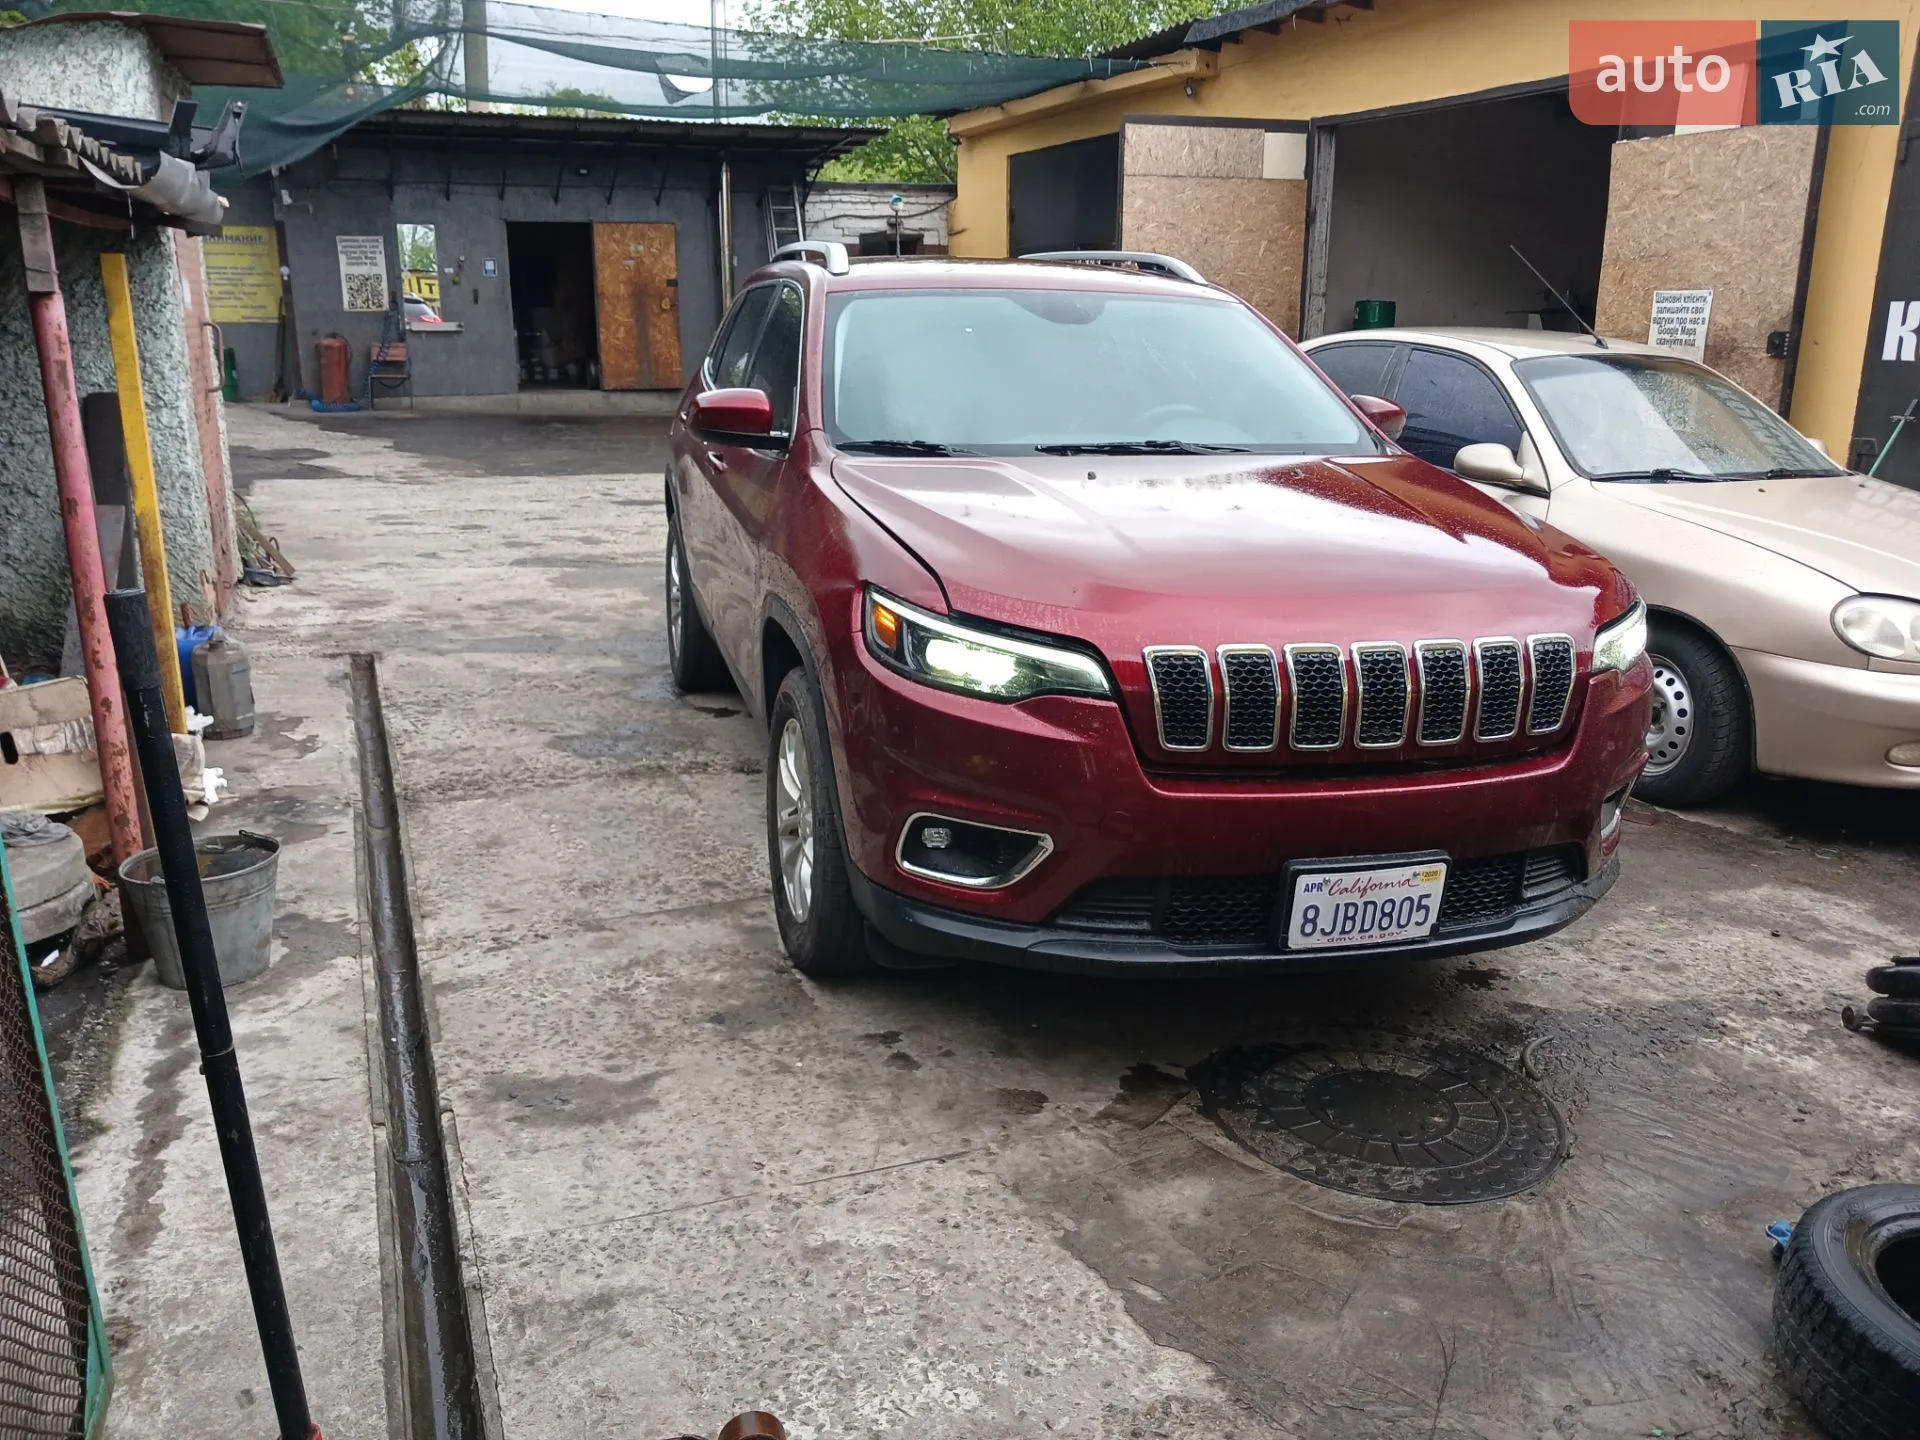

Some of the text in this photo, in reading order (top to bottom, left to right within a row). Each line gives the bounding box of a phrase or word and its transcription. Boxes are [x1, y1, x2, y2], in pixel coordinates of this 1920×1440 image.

[1675, 316, 1688, 327] про
[1688, 317, 1700, 326] нас
[1657, 325, 1697, 337] Google Maps
[1303, 882, 1324, 893] APR
[1327, 876, 1420, 899] California
[1300, 893, 1433, 938] 8JBD805
[1326, 930, 1404, 943] dmv.ca.gov
